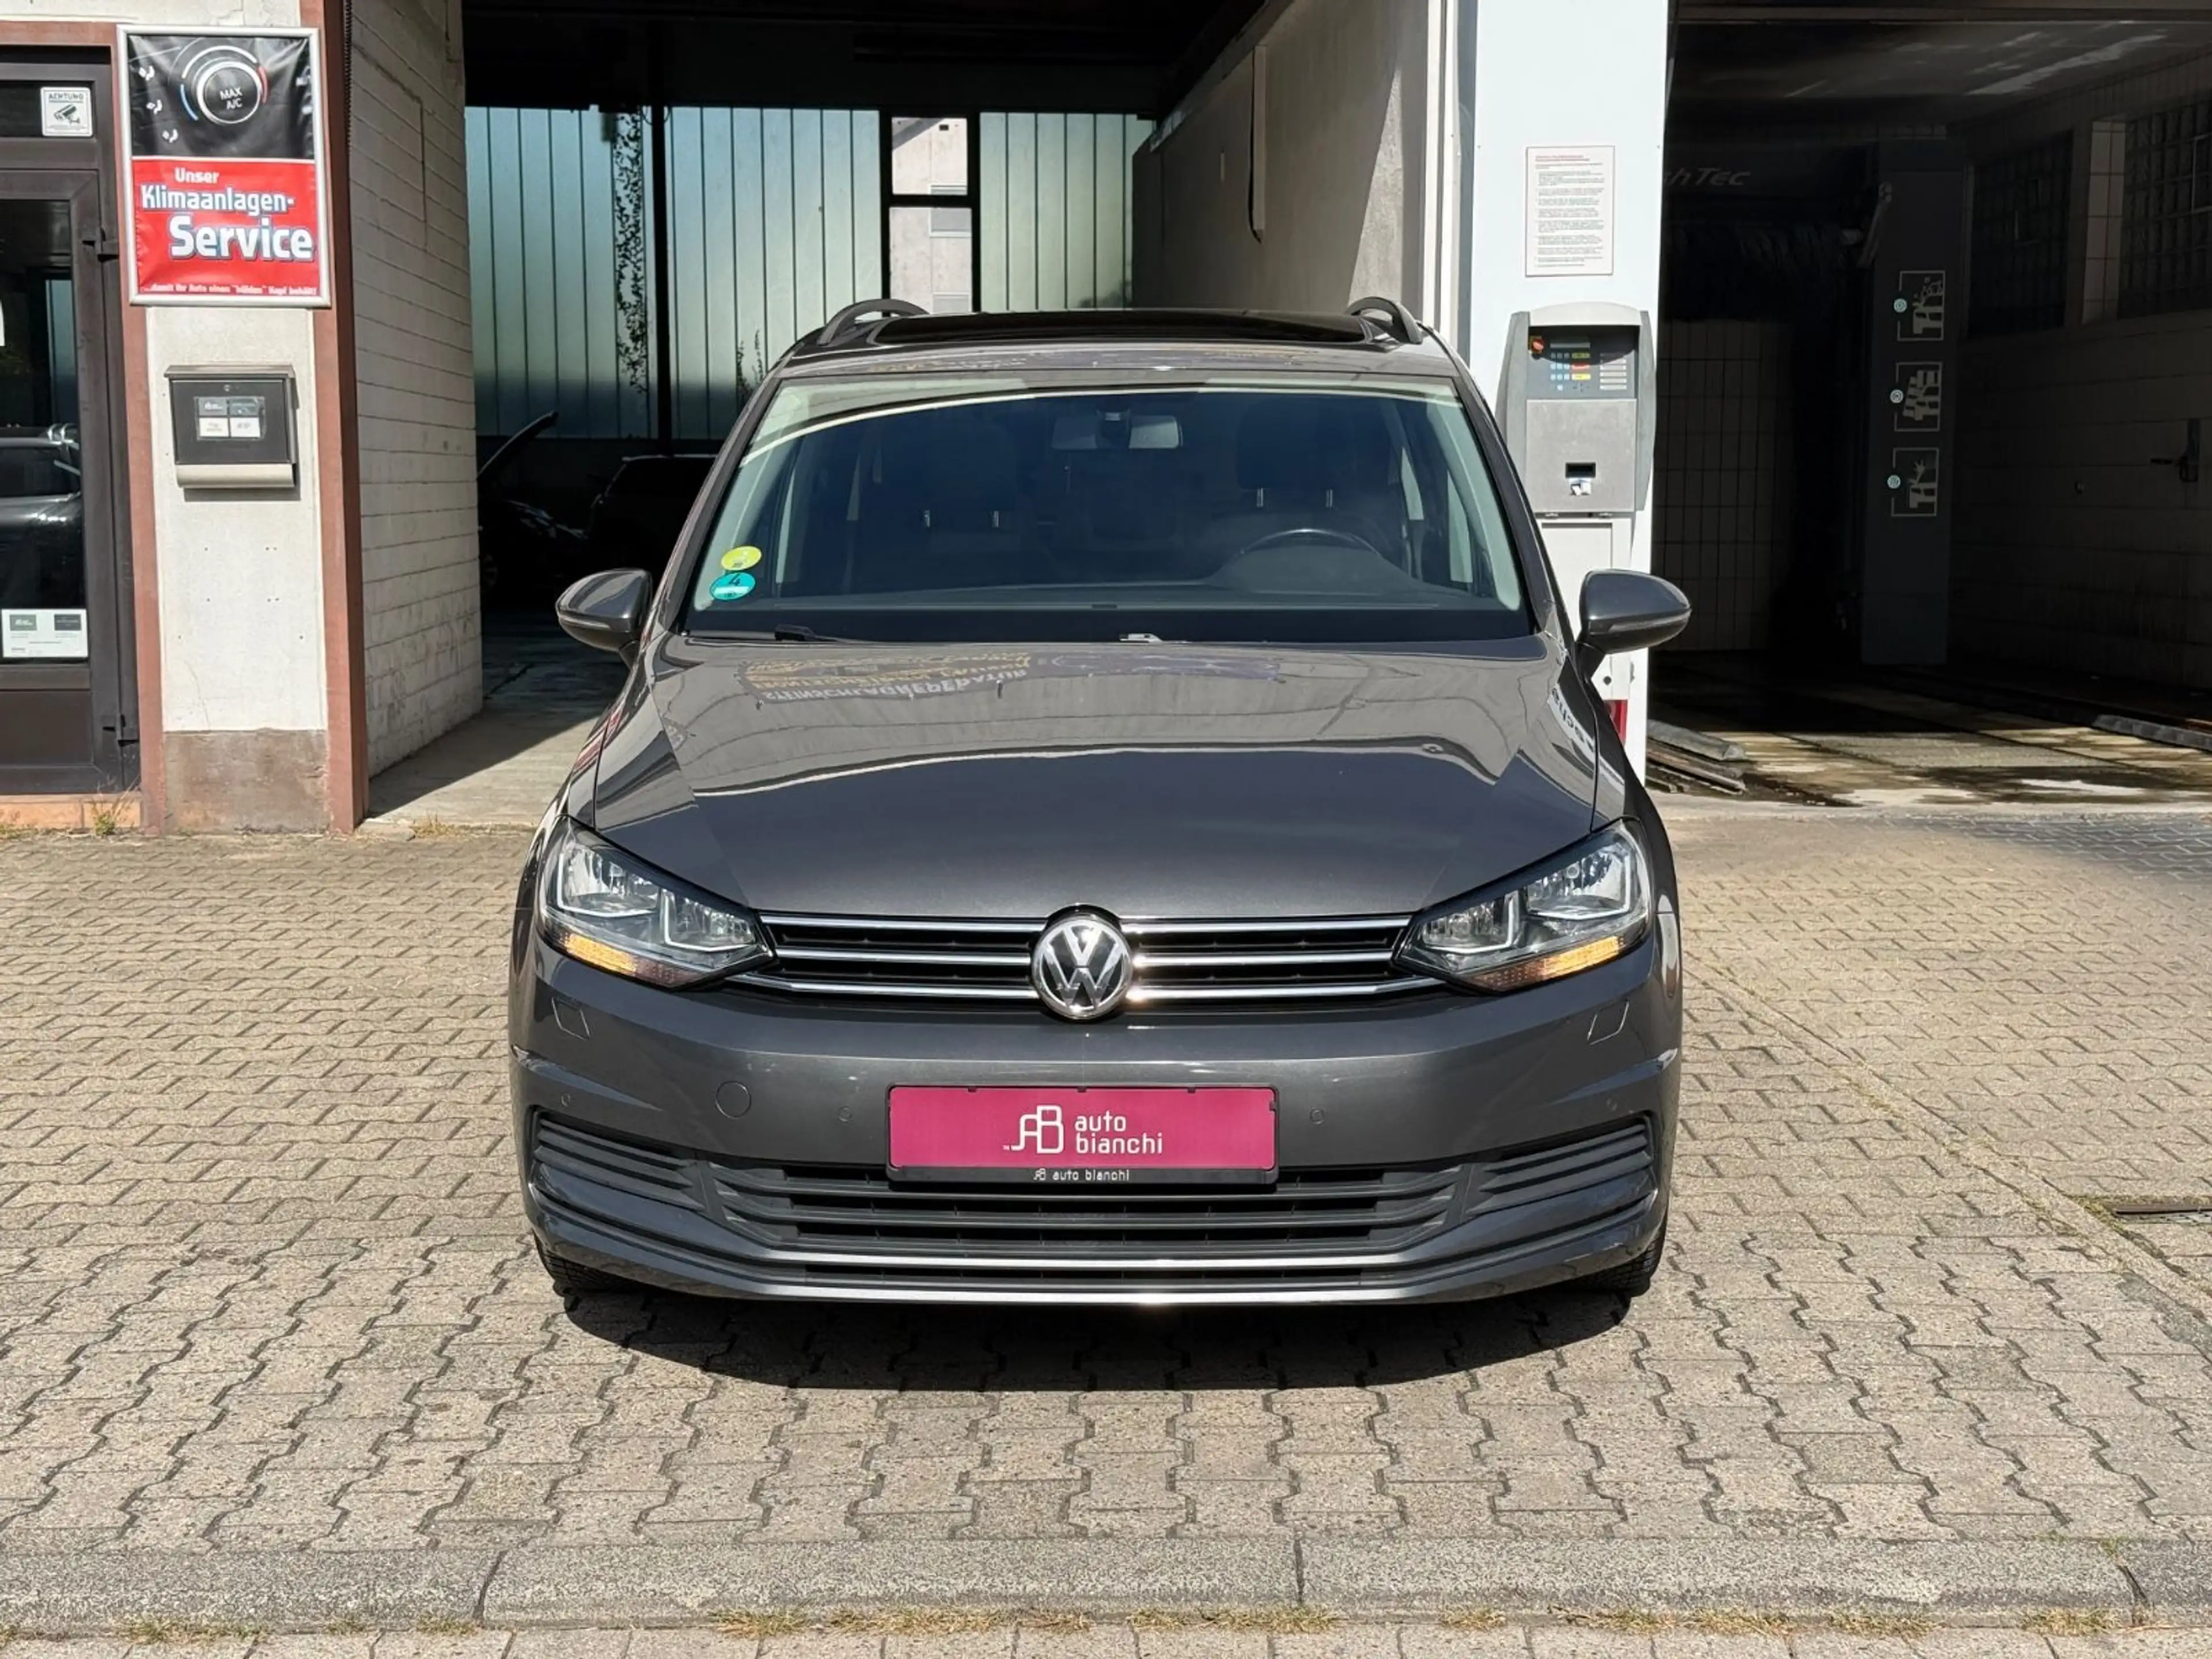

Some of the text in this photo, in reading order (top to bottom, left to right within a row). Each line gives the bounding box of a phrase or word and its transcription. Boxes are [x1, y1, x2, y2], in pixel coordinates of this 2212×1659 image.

[219, 86, 243, 100] MAX
[226, 97, 243, 109] A/C
[175, 168, 219, 183] Unser
[141, 185, 296, 216] Klimaanlagen-
[168, 214, 313, 260] Service
[728, 574, 741, 586] 4
[1035, 919, 1131, 1017] VW
[1074, 1110, 1127, 1132] auto
[1075, 1132, 1163, 1154] bianchi
[1052, 1170, 1079, 1181] auto
[1085, 1169, 1130, 1181] bianchi
